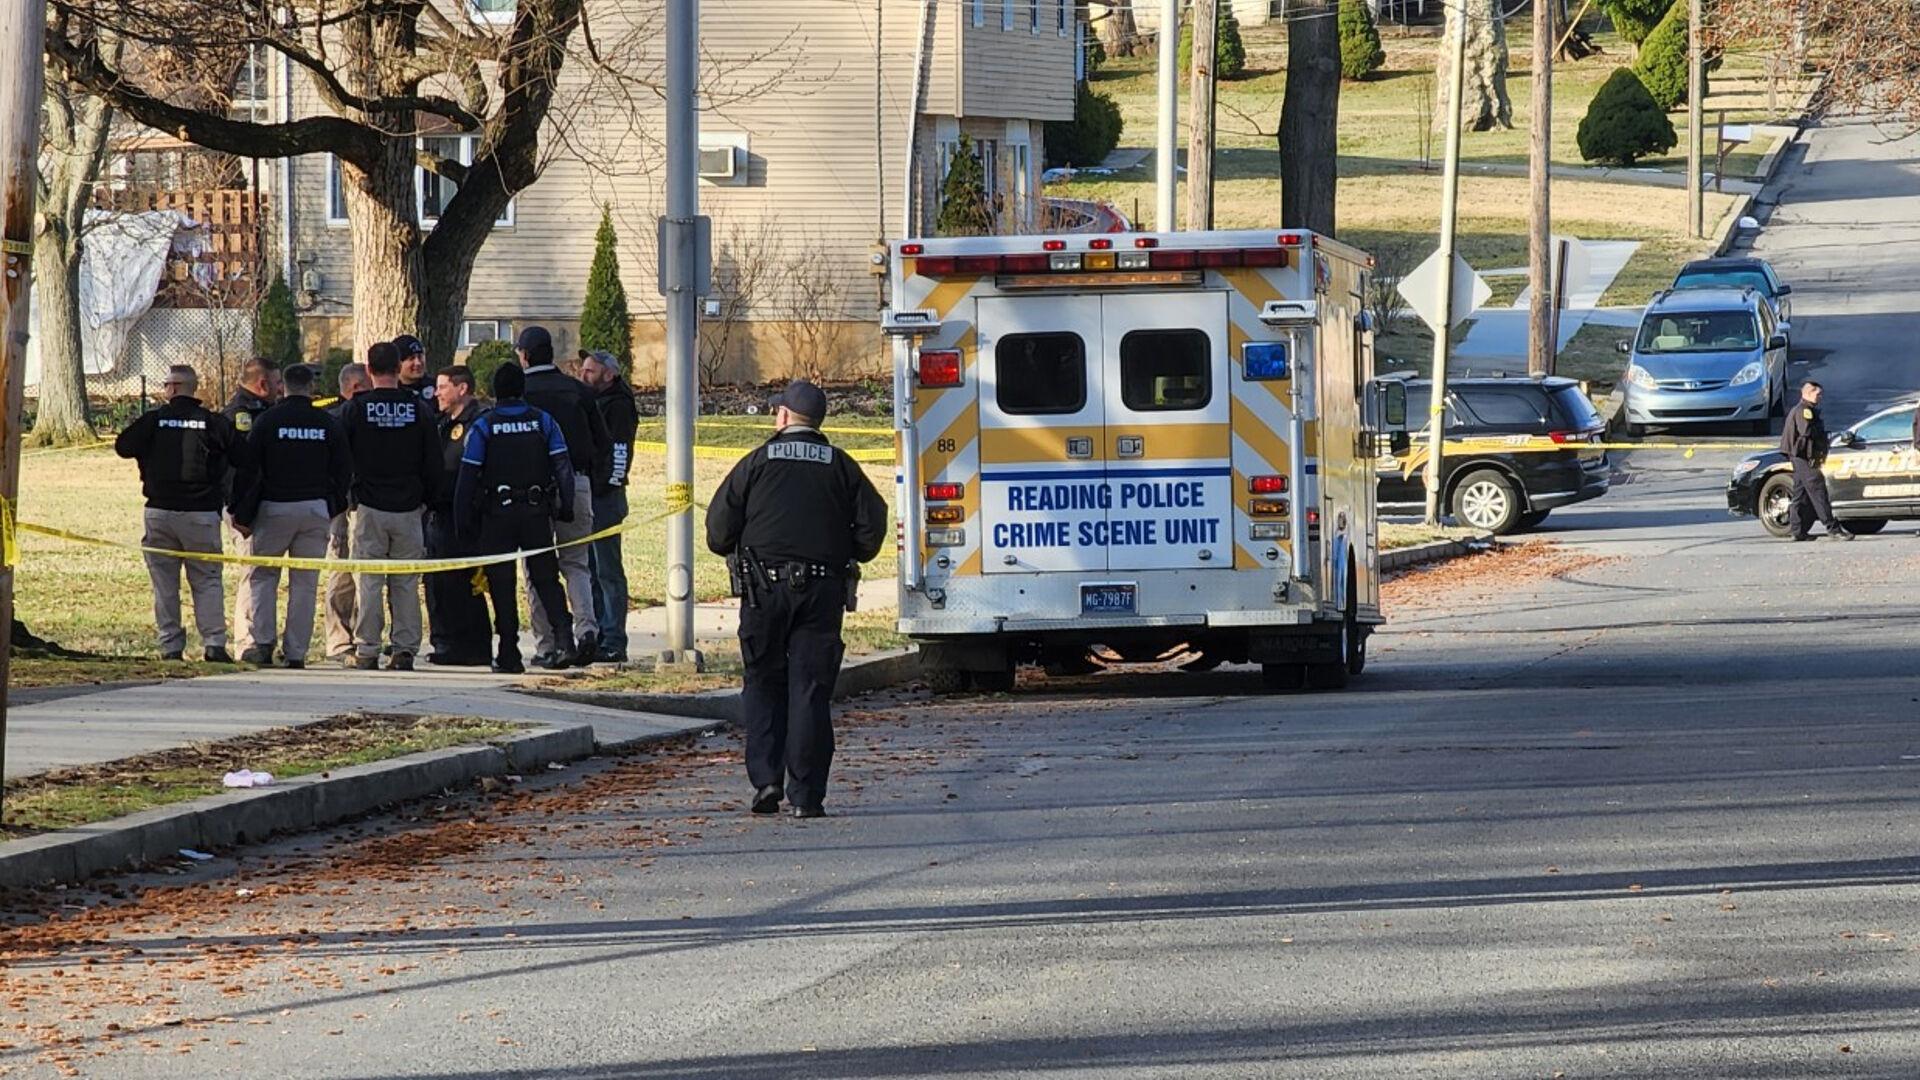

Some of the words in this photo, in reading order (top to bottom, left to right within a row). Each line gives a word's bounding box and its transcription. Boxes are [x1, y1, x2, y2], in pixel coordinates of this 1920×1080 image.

[366, 402, 416, 418] POLICE
[158, 419, 206, 429] POLICE
[492, 420, 540, 435] POLICE
[278, 427, 326, 440] POLICE
[773, 443, 827, 460] POLICE
[937, 438, 956, 453] 88
[608, 442, 628, 487] POLICE
[1008, 484, 1113, 511] READING
[1120, 482, 1204, 509] POLICE
[993, 521, 1071, 548] CRIME
[1077, 519, 1157, 546] SCENE
[1164, 518, 1220, 545] UNIT
[1086, 591, 1133, 607] MG-7987F
